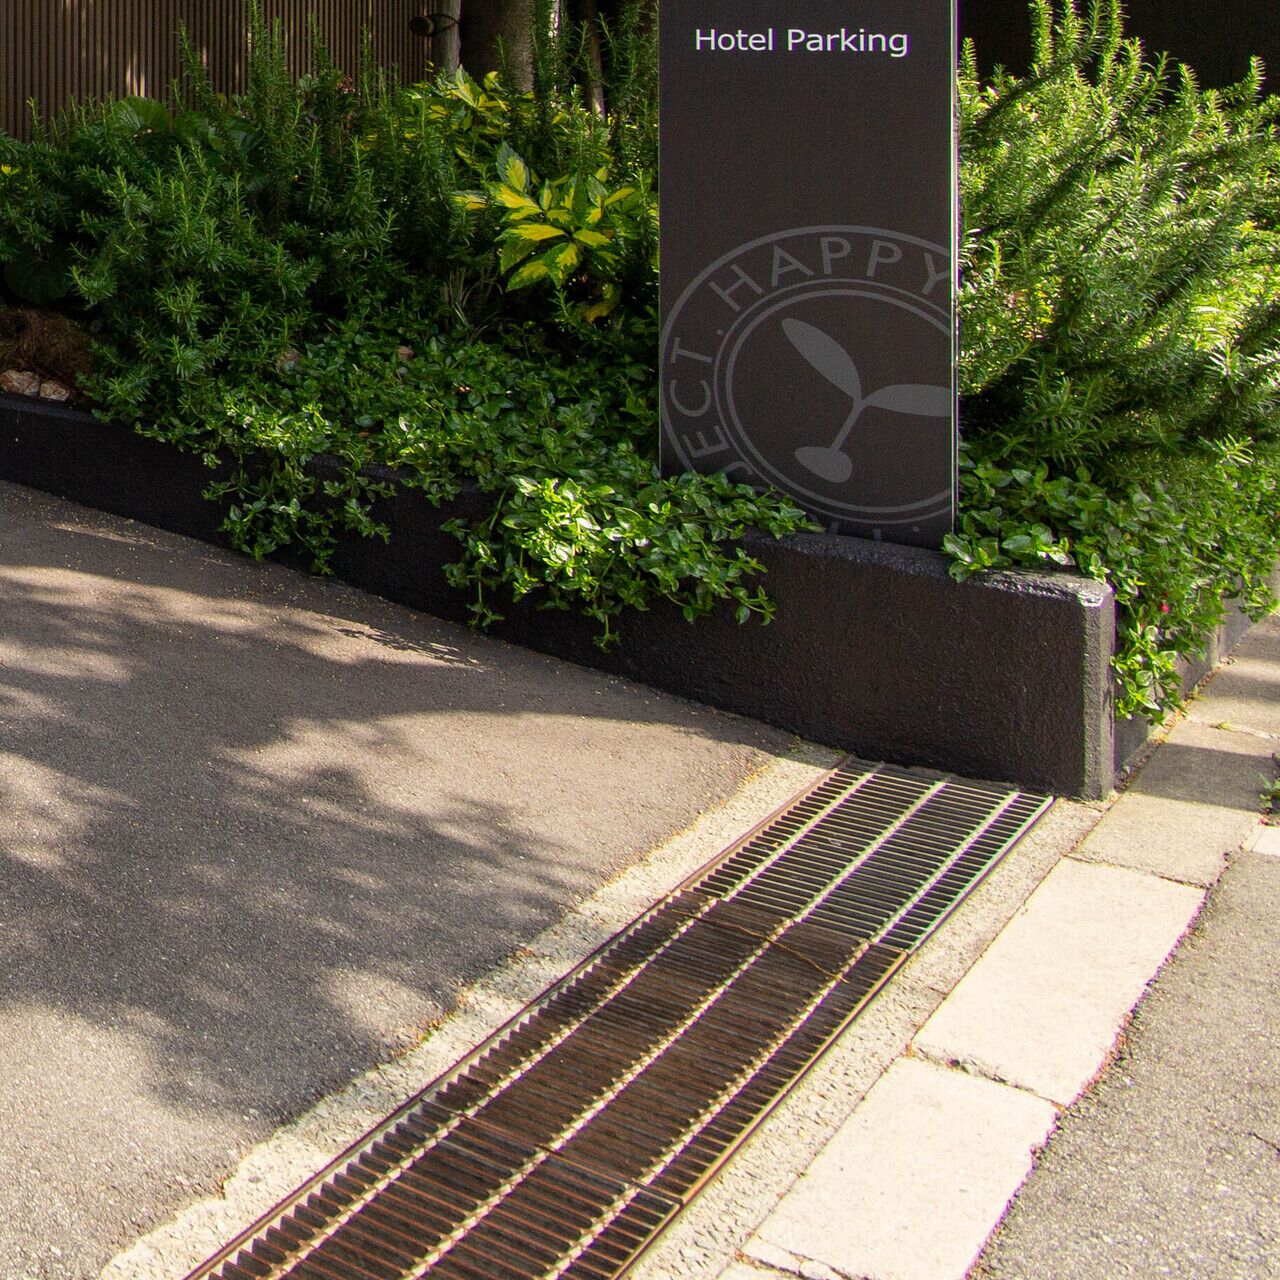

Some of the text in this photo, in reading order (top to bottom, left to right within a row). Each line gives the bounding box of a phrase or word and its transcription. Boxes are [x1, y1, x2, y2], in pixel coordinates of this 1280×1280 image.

[695, 27, 909, 57] Hotel Parking
[708, 236, 951, 312] HAPPY
